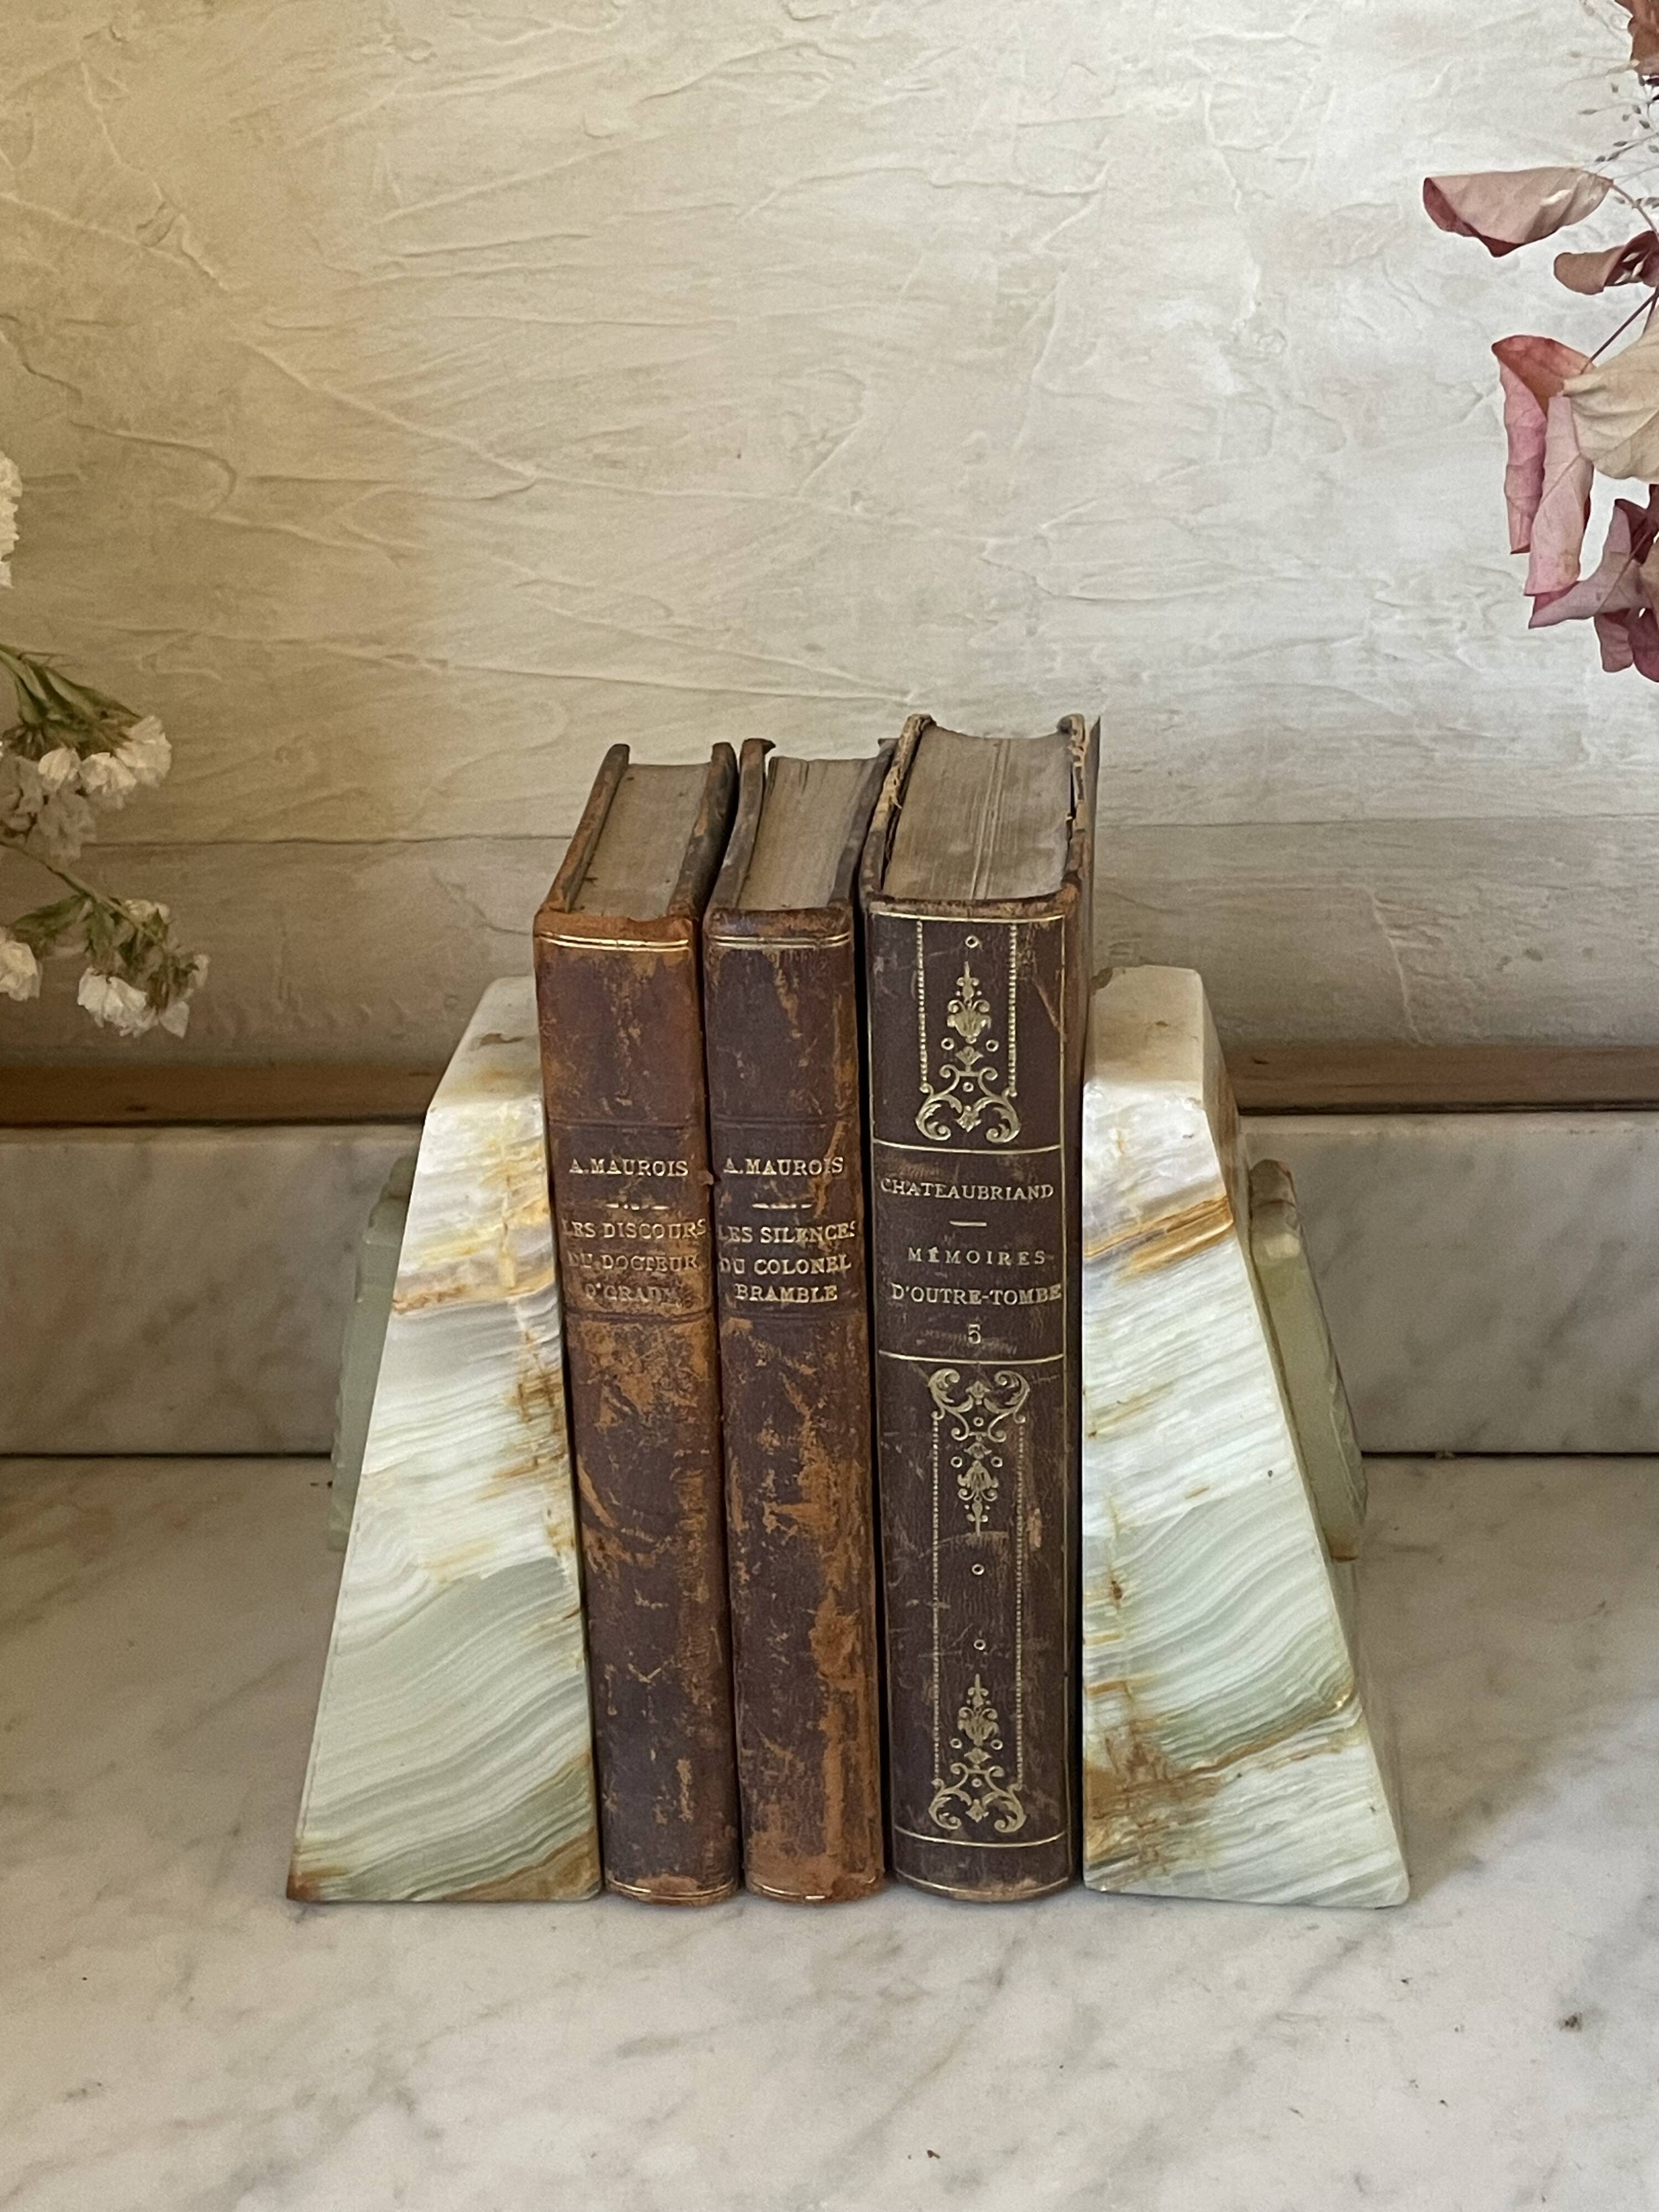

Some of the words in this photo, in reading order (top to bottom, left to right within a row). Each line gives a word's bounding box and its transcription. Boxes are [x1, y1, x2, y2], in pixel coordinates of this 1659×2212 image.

[569, 1158, 688, 1176] A.MAUROIS
[723, 1157, 843, 1175] A.MAUROIS
[880, 1178, 1054, 1200] CHATEAUBRIAND
[603, 1218, 706, 1239] DISCOURS
[719, 1224, 753, 1243] LES
[719, 1256, 745, 1275] DU
[754, 1254, 852, 1275] COLONEL
[735, 1283, 837, 1303] BRAMBLE
[891, 1282, 1061, 1305] D'OUTRE-TOMBE
[968, 1324, 981, 1344] 5
